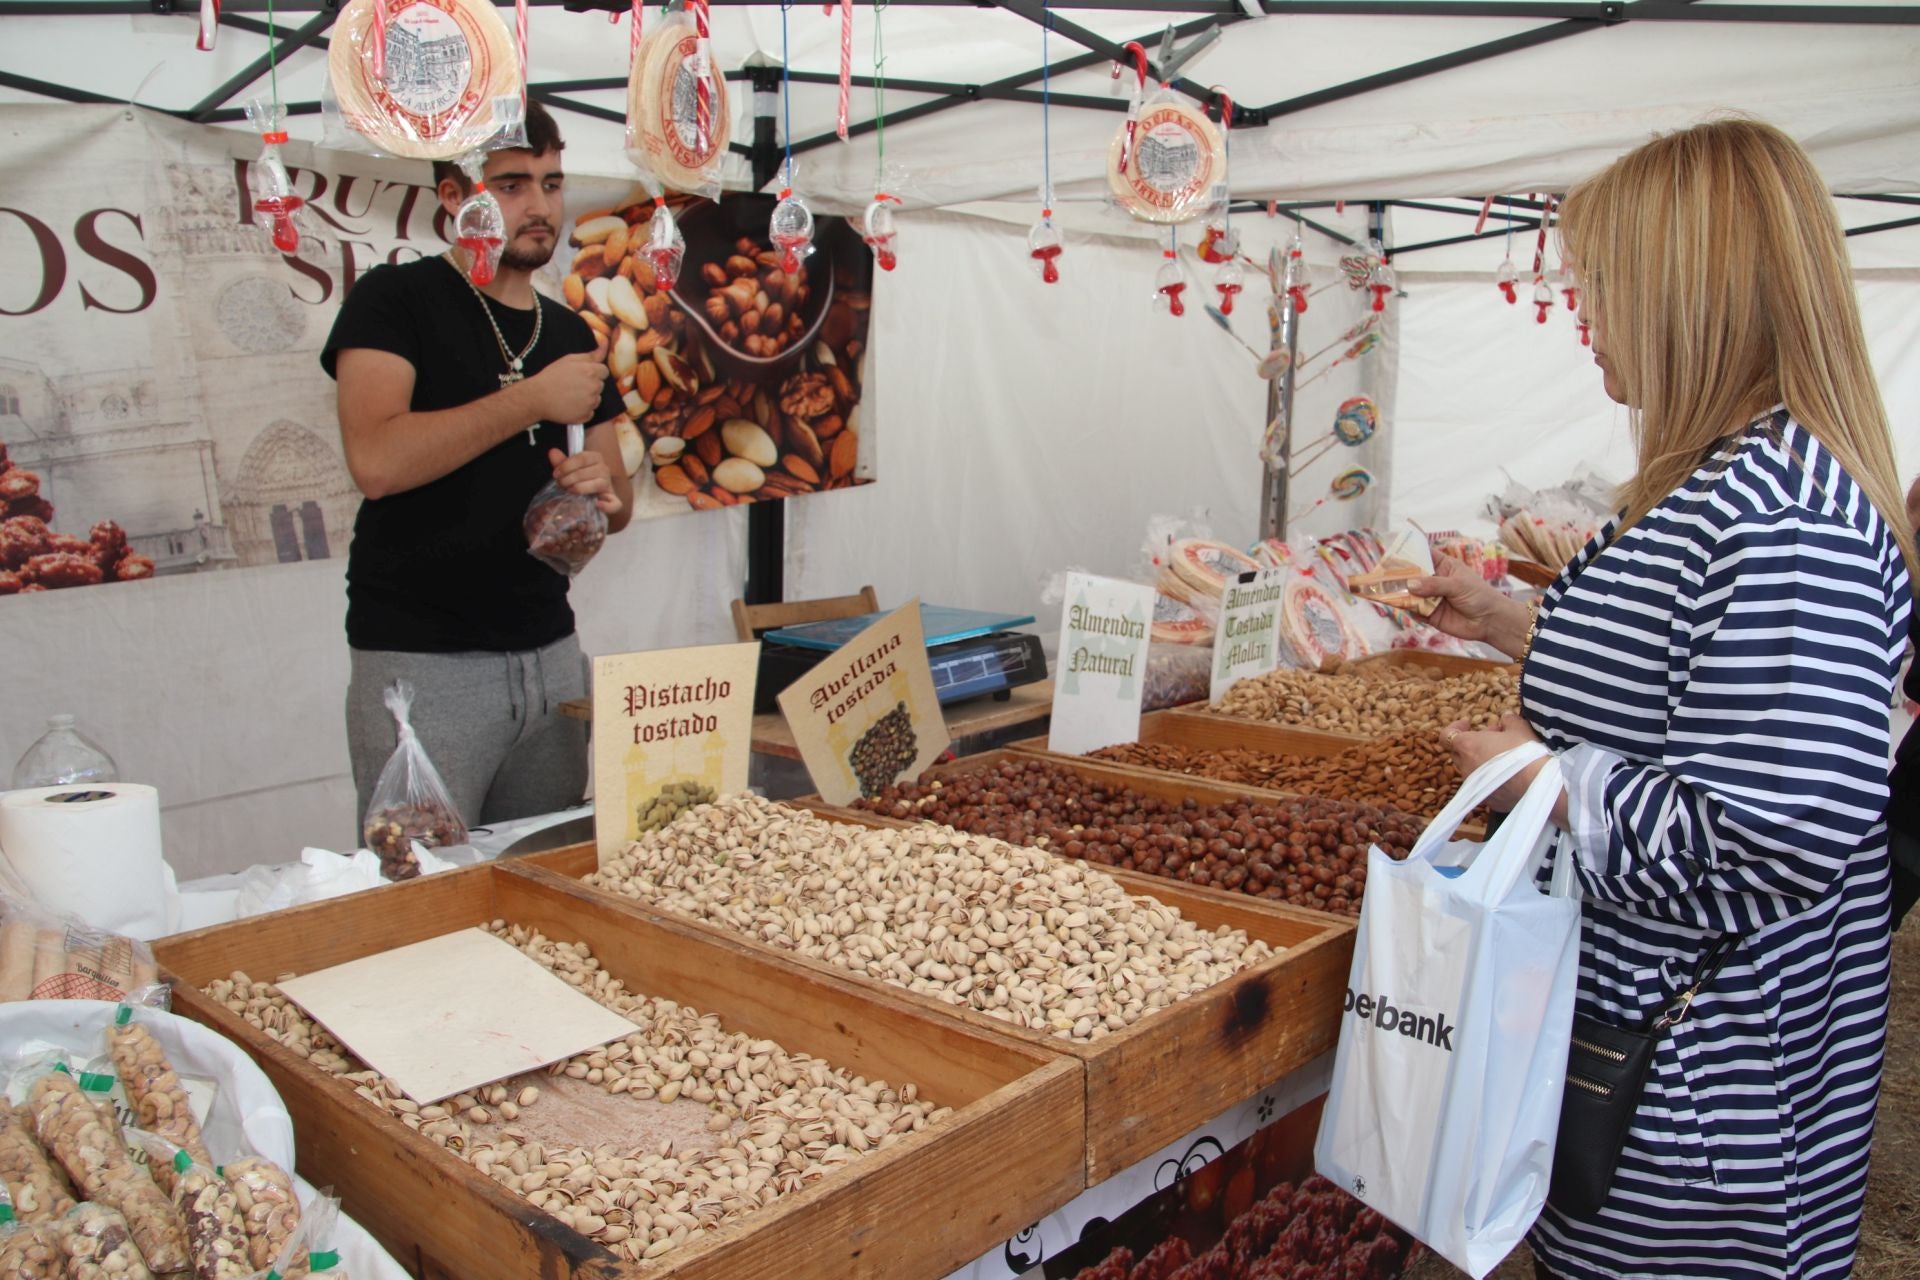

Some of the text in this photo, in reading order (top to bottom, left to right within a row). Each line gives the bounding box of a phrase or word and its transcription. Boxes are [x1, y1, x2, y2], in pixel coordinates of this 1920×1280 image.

[1224, 584, 1282, 610] Almendra
[1068, 604, 1146, 640] Almendra
[1225, 612, 1273, 639] Tostada
[1067, 646, 1136, 677] Natural
[1225, 641, 1267, 670] Mollar
[810, 632, 903, 713] Avellana
[622, 676, 731, 717] Pistacho
[826, 660, 898, 725] tostada
[633, 712, 718, 745] tostado
